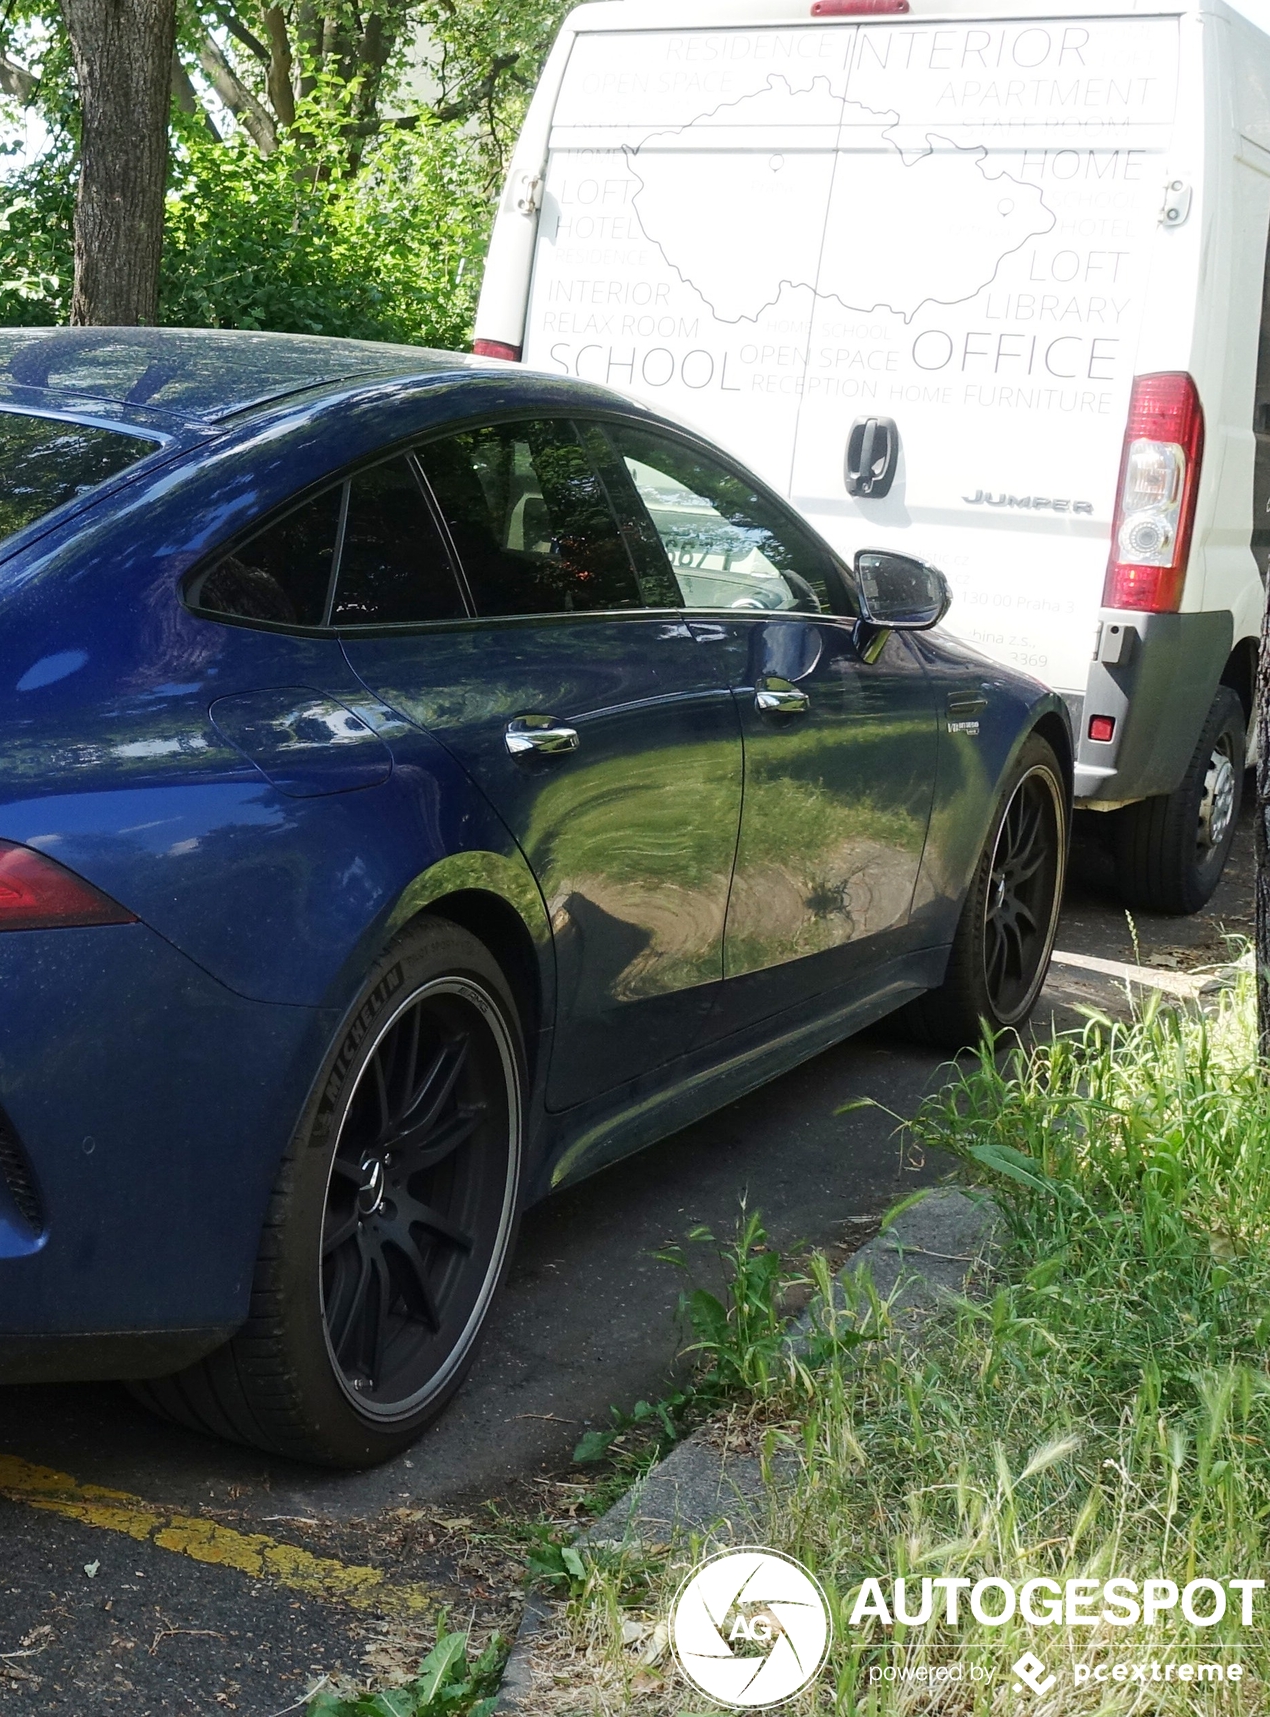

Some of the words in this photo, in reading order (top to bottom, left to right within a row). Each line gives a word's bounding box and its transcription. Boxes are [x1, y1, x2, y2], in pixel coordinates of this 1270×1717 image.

[666, 33, 836, 61] RESIDENCE
[842, 27, 1090, 70] INTERIOR
[582, 73, 649, 95] OPEN
[658, 71, 732, 94] SPACE
[935, 77, 1157, 107] APARTMENT
[1020, 149, 1146, 181] HOME
[561, 178, 637, 205] LOFT
[556, 216, 639, 240] HOTEL
[1060, 218, 1136, 238] HOTEL
[555, 248, 649, 266] RESIDENCE
[1029, 249, 1131, 283] LOFT
[548, 279, 671, 306] INTERIOR
[985, 293, 1132, 324] LIBRARY
[542, 311, 615, 335] RELAX
[621, 315, 699, 338] ROOM
[766, 320, 812, 335] HOME
[821, 323, 892, 341] SCHOOL
[550, 342, 741, 392] SCHOOL
[739, 344, 810, 368] OPEN
[818, 347, 901, 371] SPACE
[911, 329, 1120, 381] OFFICE
[751, 374, 878, 398] RECEPTION
[889, 384, 953, 404] HOME
[963, 384, 1113, 415] FURNITURE
[961, 489, 1095, 516] JUMPER
[1016, 595, 1061, 613] Praha
[325, 960, 406, 1109] MICHELIN
